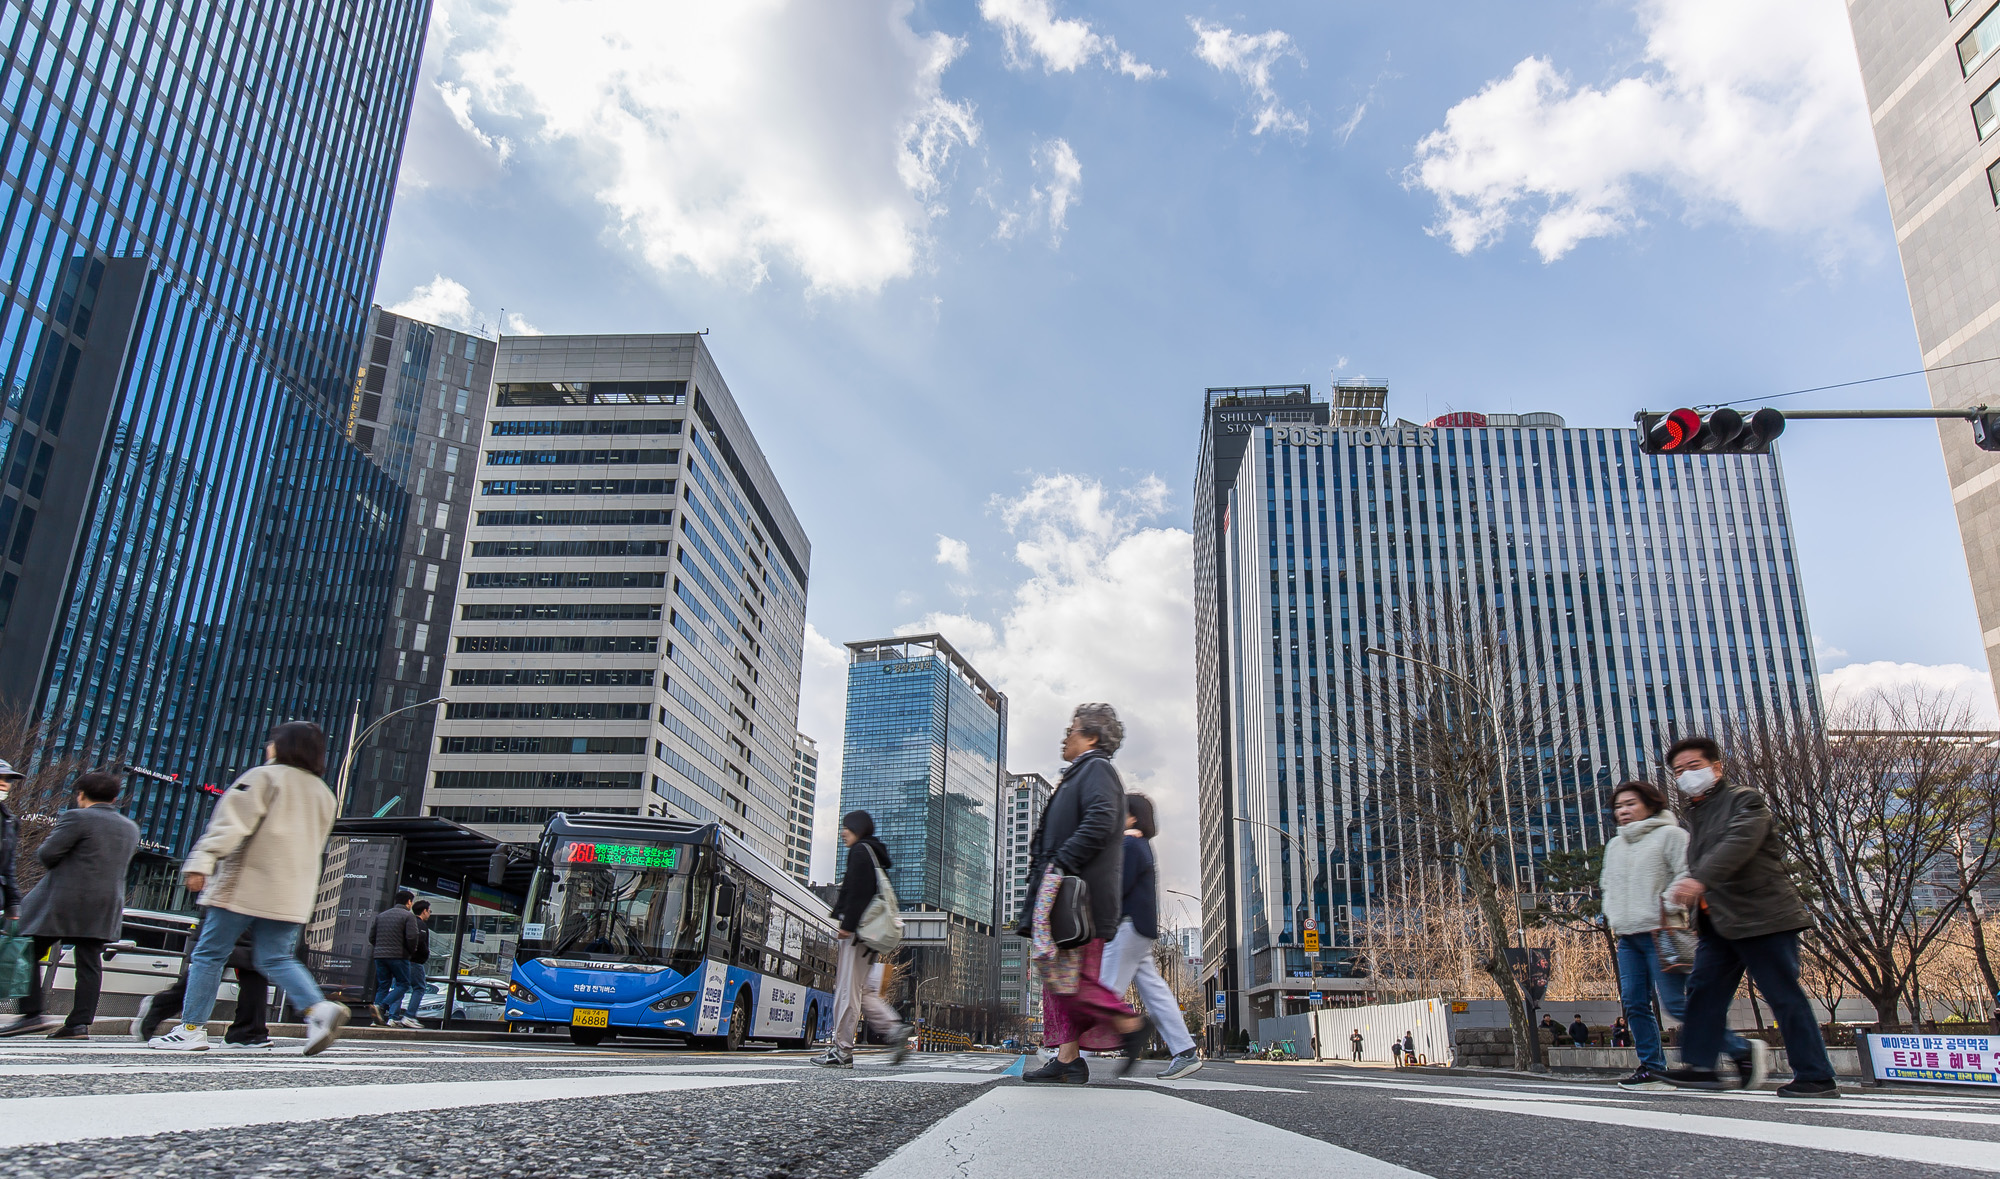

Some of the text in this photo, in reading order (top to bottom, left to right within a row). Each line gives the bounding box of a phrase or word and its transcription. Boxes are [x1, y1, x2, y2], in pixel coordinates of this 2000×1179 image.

[1220, 412, 1263, 422] SHILLA
[1227, 423, 1255, 433] STAY
[1273, 427, 1436, 447] POST TOWER
[133, 766, 173, 782] ASIANA AIRLINES
[567, 842, 596, 863] 260
[573, 984, 616, 993] 친환경 전기버스
[1881, 1036, 1989, 1051] 에이원짐 마포 공덕역점
[1893, 1051, 1940, 1068] 트리플
[1949, 1052, 1982, 1070] 혜택
[1935, 1071, 1942, 1079] 수
